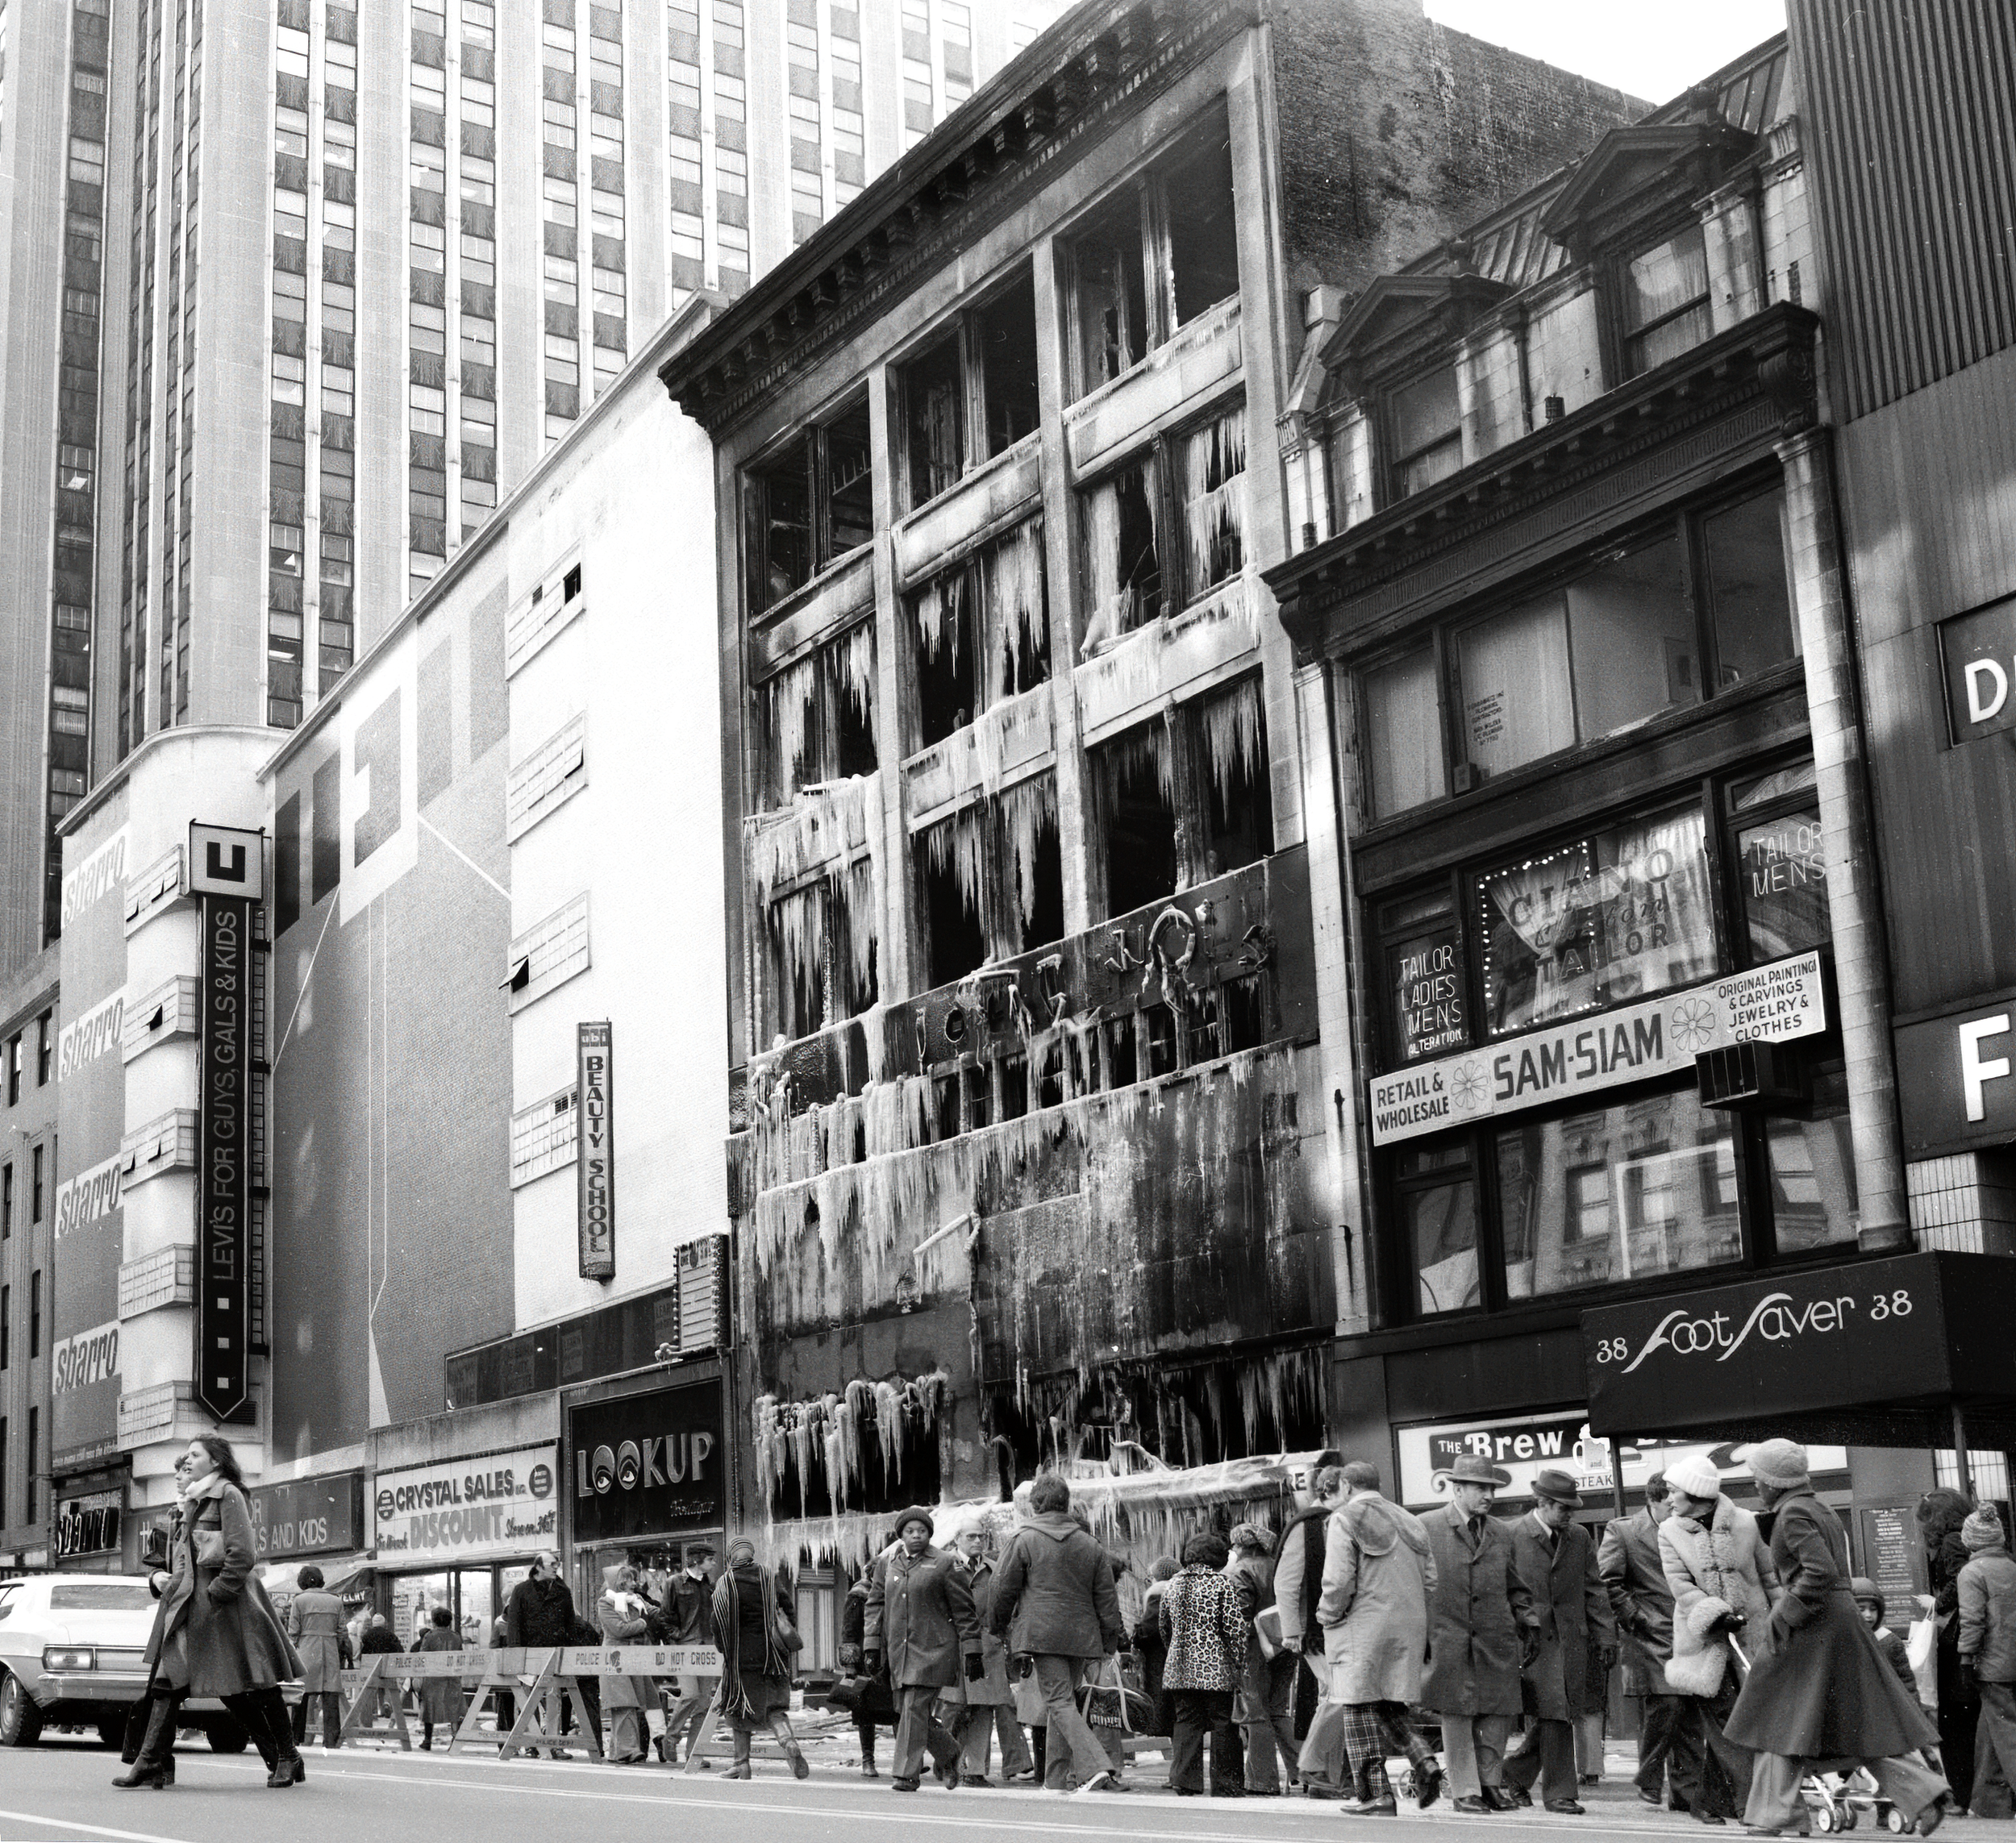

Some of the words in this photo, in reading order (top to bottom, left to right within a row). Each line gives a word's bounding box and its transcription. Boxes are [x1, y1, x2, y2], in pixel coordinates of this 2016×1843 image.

[1964, 655, 2016, 724] D
[1753, 822, 1823, 866] TAILOR
[65, 835, 125, 926] sbarro
[1509, 848, 1675, 927] CIANO
[1753, 853, 1826, 897] MENS
[215, 911, 236, 969] KIDS
[1535, 923, 1669, 983] TAILOR
[215, 974, 236, 991] &
[1400, 945, 1455, 982] TAILOR
[1401, 974, 1456, 1011] LADIES
[1718, 974, 1767, 999] ORIGINAL
[1729, 997, 1737, 1010] &
[1739, 979, 1803, 1007] CARVINGS
[215, 996, 236, 1064] GALS
[1408, 999, 1462, 1036] MENS
[1729, 996, 1797, 1028] JEWELRY
[1800, 994, 1809, 1008] &
[1735, 1014, 1802, 1042] CLOTHES
[62, 996, 123, 1080] sbarro
[1408, 1028, 1463, 1056] ALTERATION
[214, 1068, 240, 1139] GUYS,
[586, 1056, 605, 1149] BEAUTY
[1377, 1075, 1431, 1108] RETAIL
[1432, 1071, 1444, 1092] &
[1377, 1096, 1450, 1133] WHOLESALE
[213, 1146, 235, 1197] FOR
[59, 1163, 121, 1238] sbarro
[587, 1159, 607, 1253] SCHOOL
[209, 1206, 235, 1281] LEVI'S
[1596, 1337, 1628, 1363] 38
[1621, 1309, 1734, 1374] Foot
[1715, 1292, 1856, 1362] Saver
[1870, 1290, 1913, 1321] 38
[56, 1329, 119, 1394] sbarro
[577, 1432, 714, 1497] LOOKUP
[1438, 1440, 1462, 1454] THE
[1464, 1430, 1564, 1461] Brew
[396, 1479, 463, 1512] CRYSTAL
[464, 1469, 514, 1503] SALES
[1574, 1474, 1613, 1488] STEAK
[271, 1522, 294, 1551] AND
[298, 1516, 327, 1546] KIDS
[410, 1504, 504, 1550] DISCOUNT
[341, 1590, 365, 1603] ELRY
[576, 1652, 599, 1666] POLICE
[656, 1652, 665, 1666] DO
[670, 1652, 685, 1666] NOT
[691, 1652, 716, 1666] CROSS
